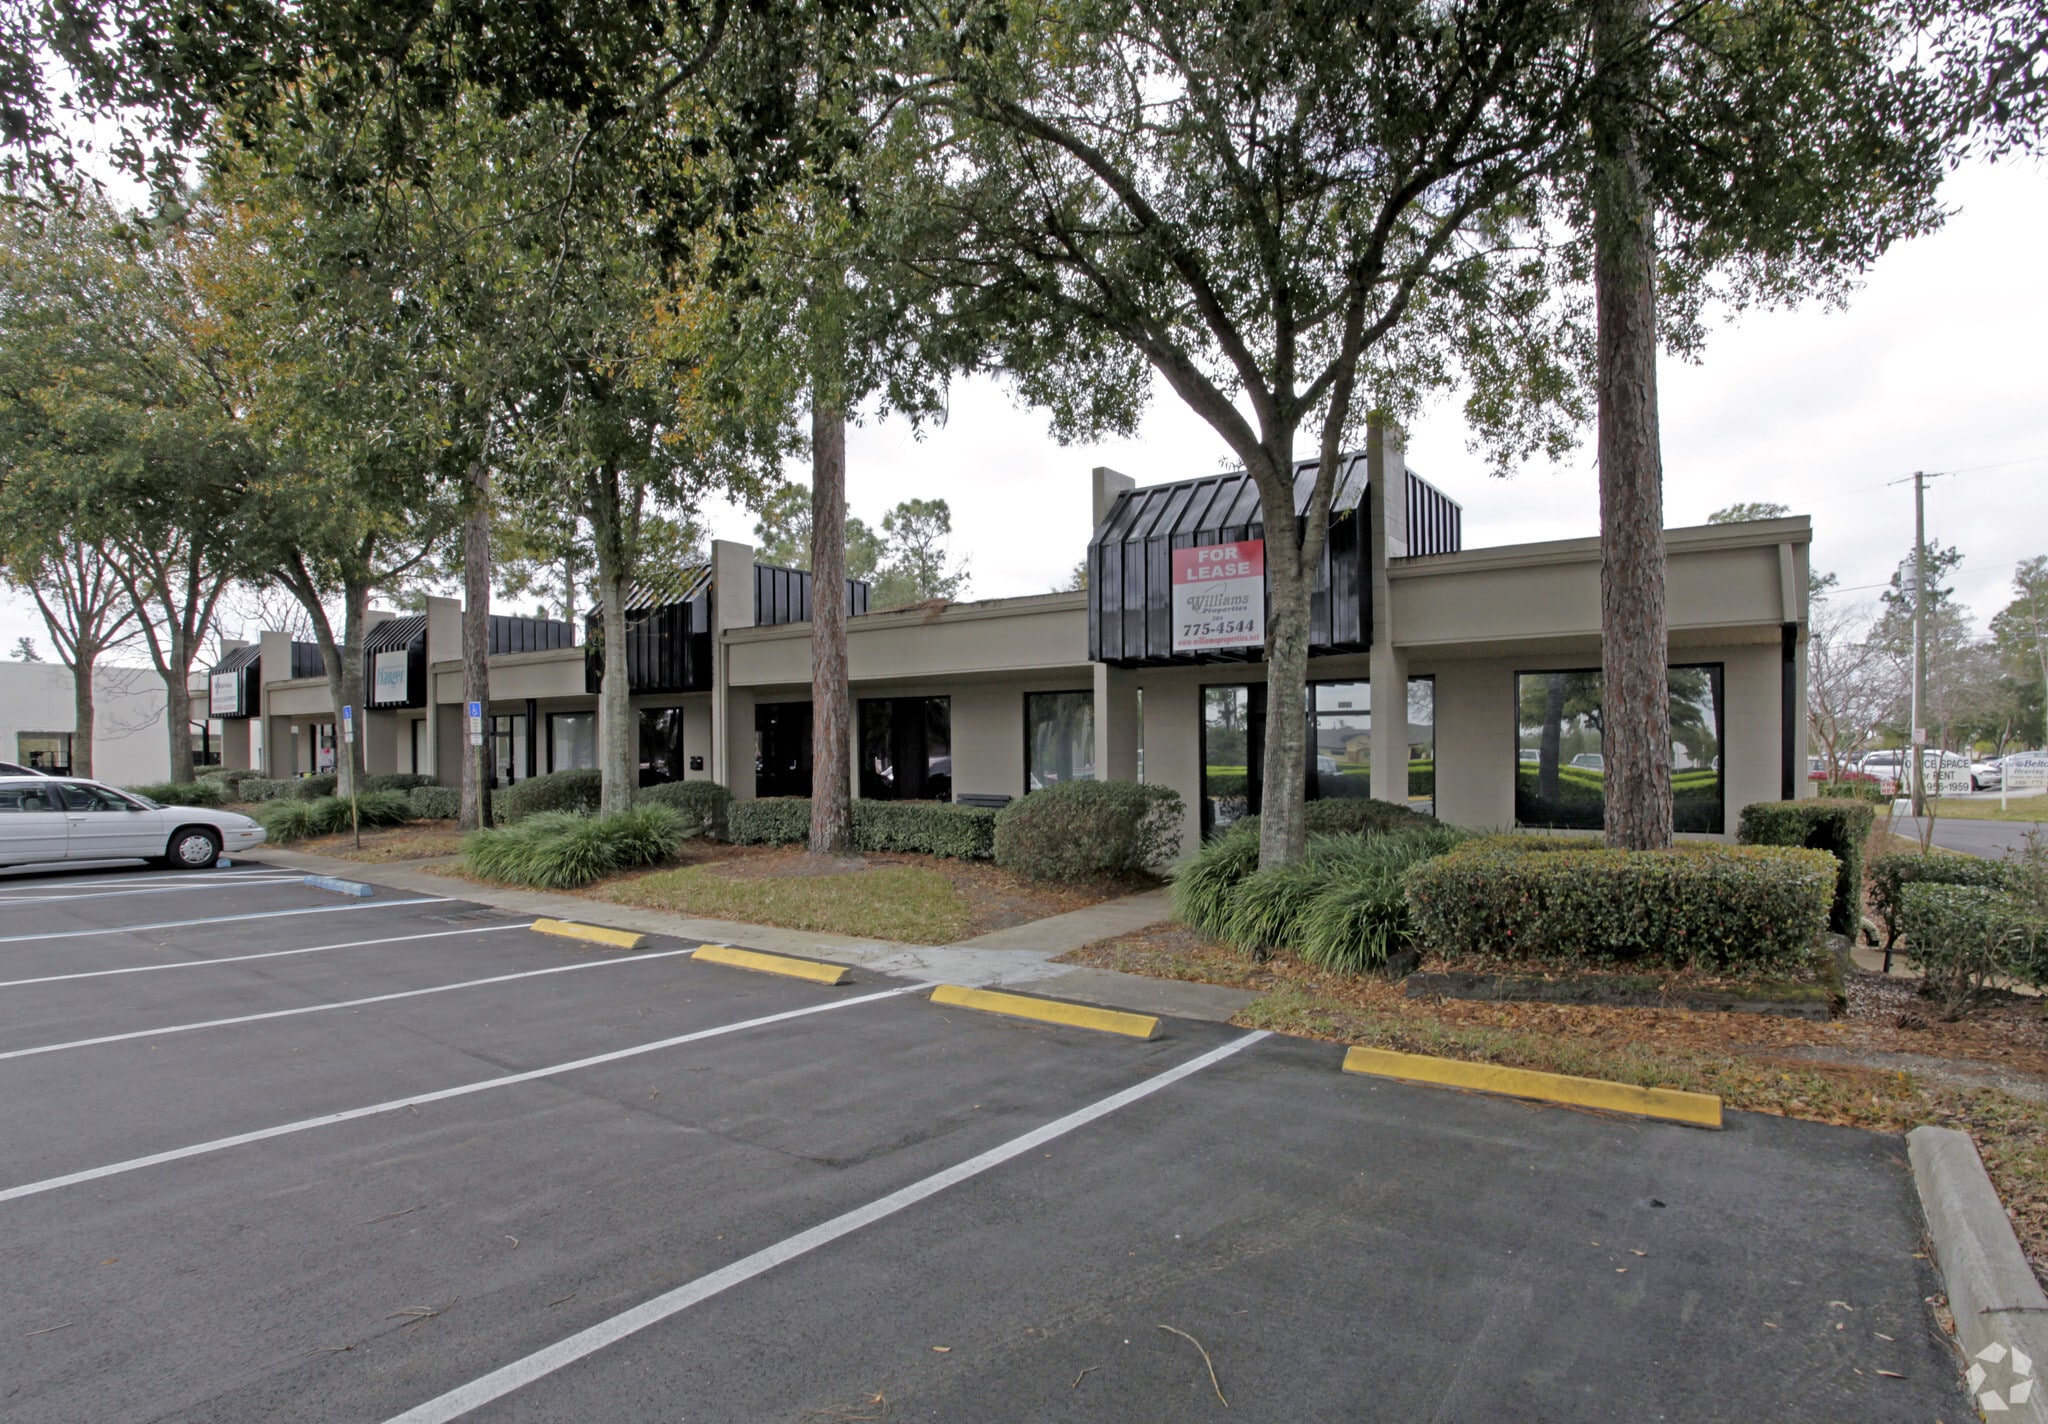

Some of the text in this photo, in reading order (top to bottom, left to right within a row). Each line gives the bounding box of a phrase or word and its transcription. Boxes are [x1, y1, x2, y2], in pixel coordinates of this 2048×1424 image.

[1198, 546, 1238, 563] FOR
[1186, 562, 1250, 580] LEASE
[1186, 593, 1249, 612] Williams
[1203, 605, 1248, 614] Properties
[1184, 619, 1254, 637] 775-4544
[1177, 634, 1260, 646] www.williamsproperties.net
[1940, 759, 1970, 769] SPACE
